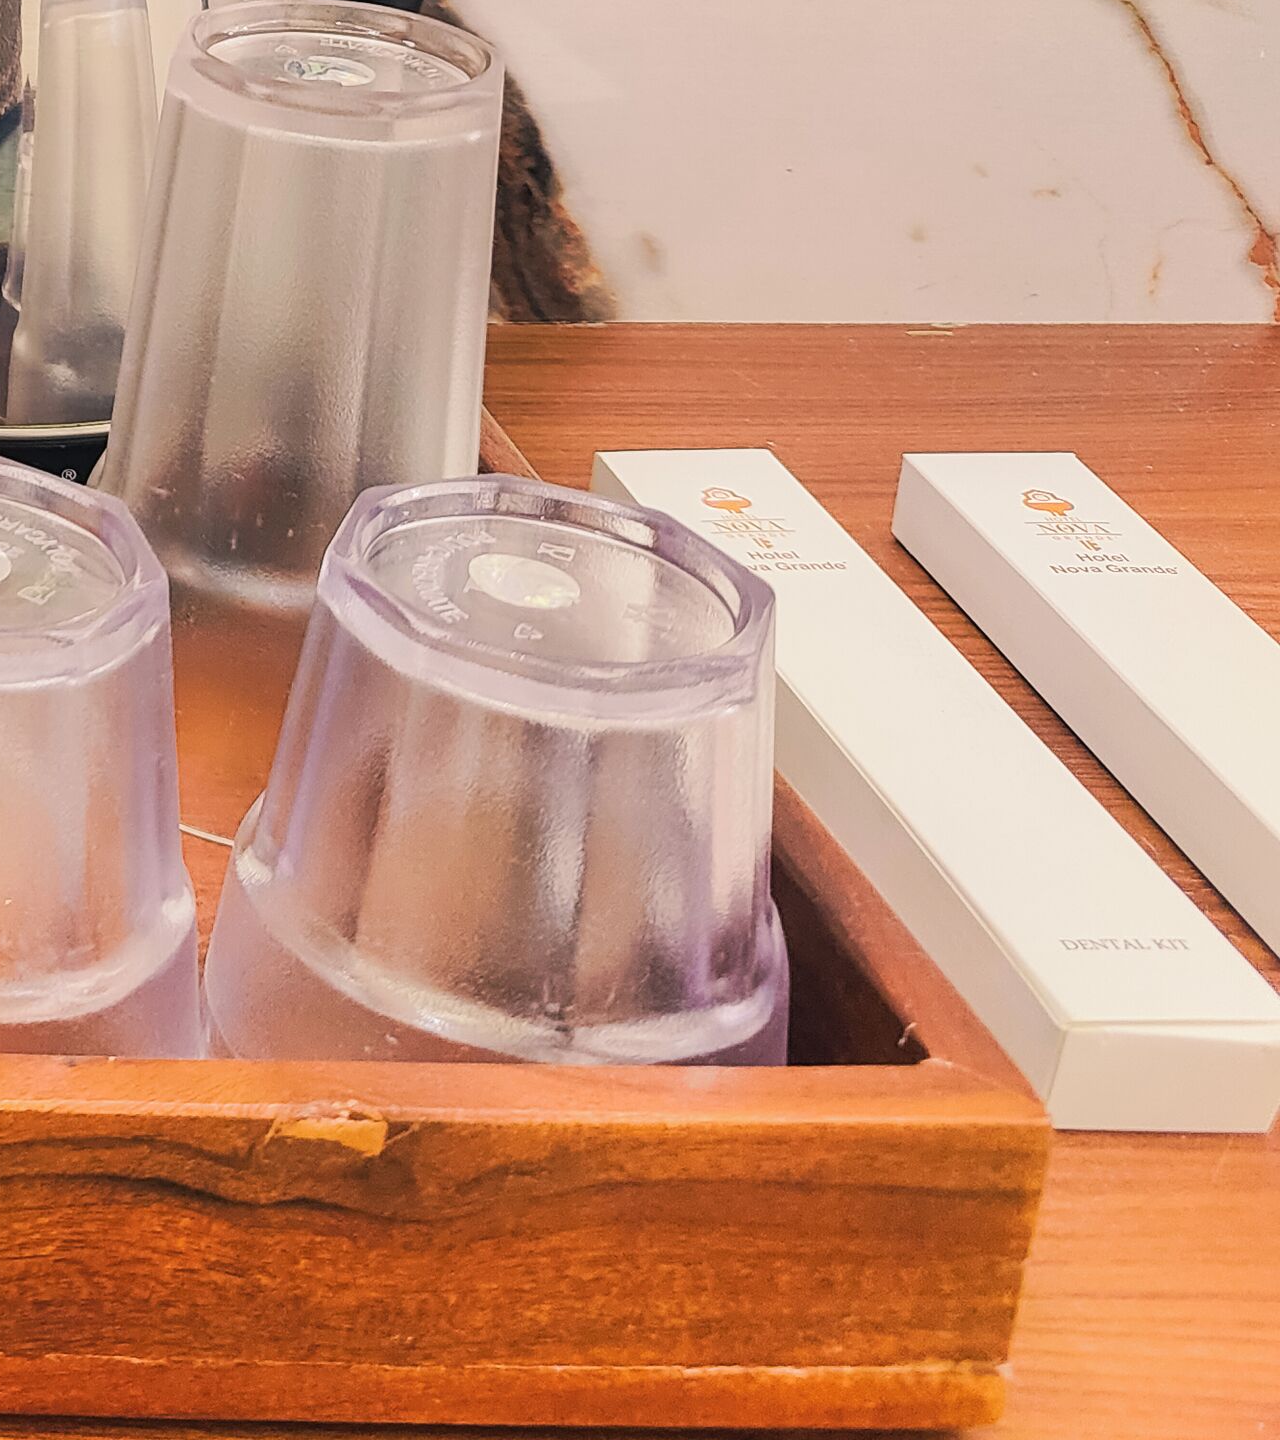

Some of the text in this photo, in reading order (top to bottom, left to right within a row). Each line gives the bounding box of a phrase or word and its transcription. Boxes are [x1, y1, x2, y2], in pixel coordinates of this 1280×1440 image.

[1037, 523, 1111, 534] NOVA
[746, 550, 800, 561] Hotel
[1075, 553, 1130, 562] Hotel
[747, 562, 771, 571] va
[1049, 564, 1102, 575] Nova
[1059, 938, 1190, 951] DENTAL KIT
